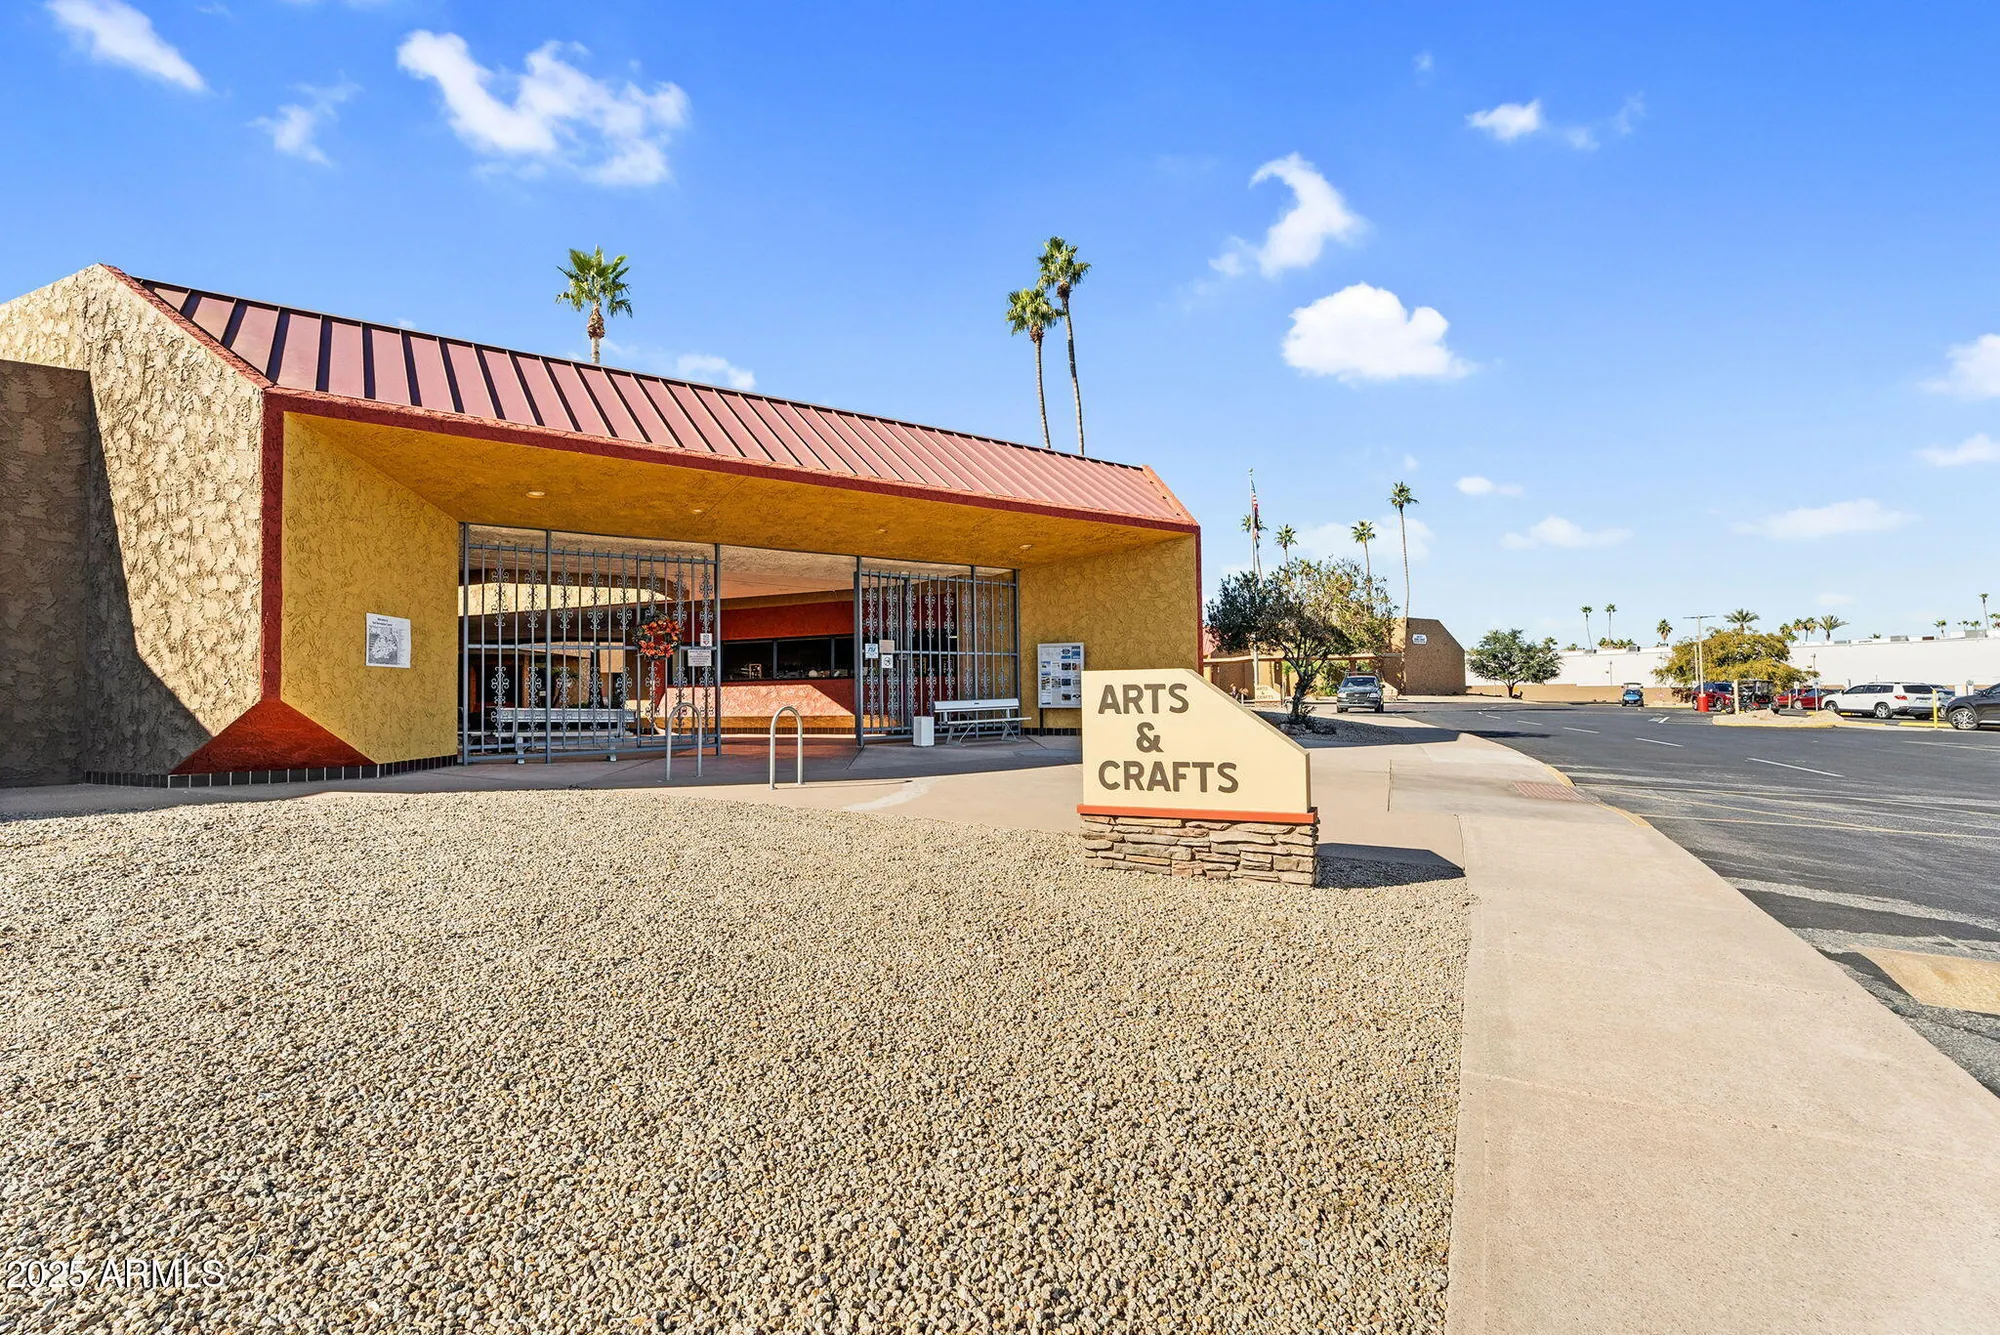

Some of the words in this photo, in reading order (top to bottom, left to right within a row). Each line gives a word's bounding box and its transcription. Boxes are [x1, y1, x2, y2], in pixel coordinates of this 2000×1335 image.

[1098, 683, 1189, 714] ARTS
[1136, 722, 1164, 753] &
[1098, 760, 1239, 793] CRAFTS
